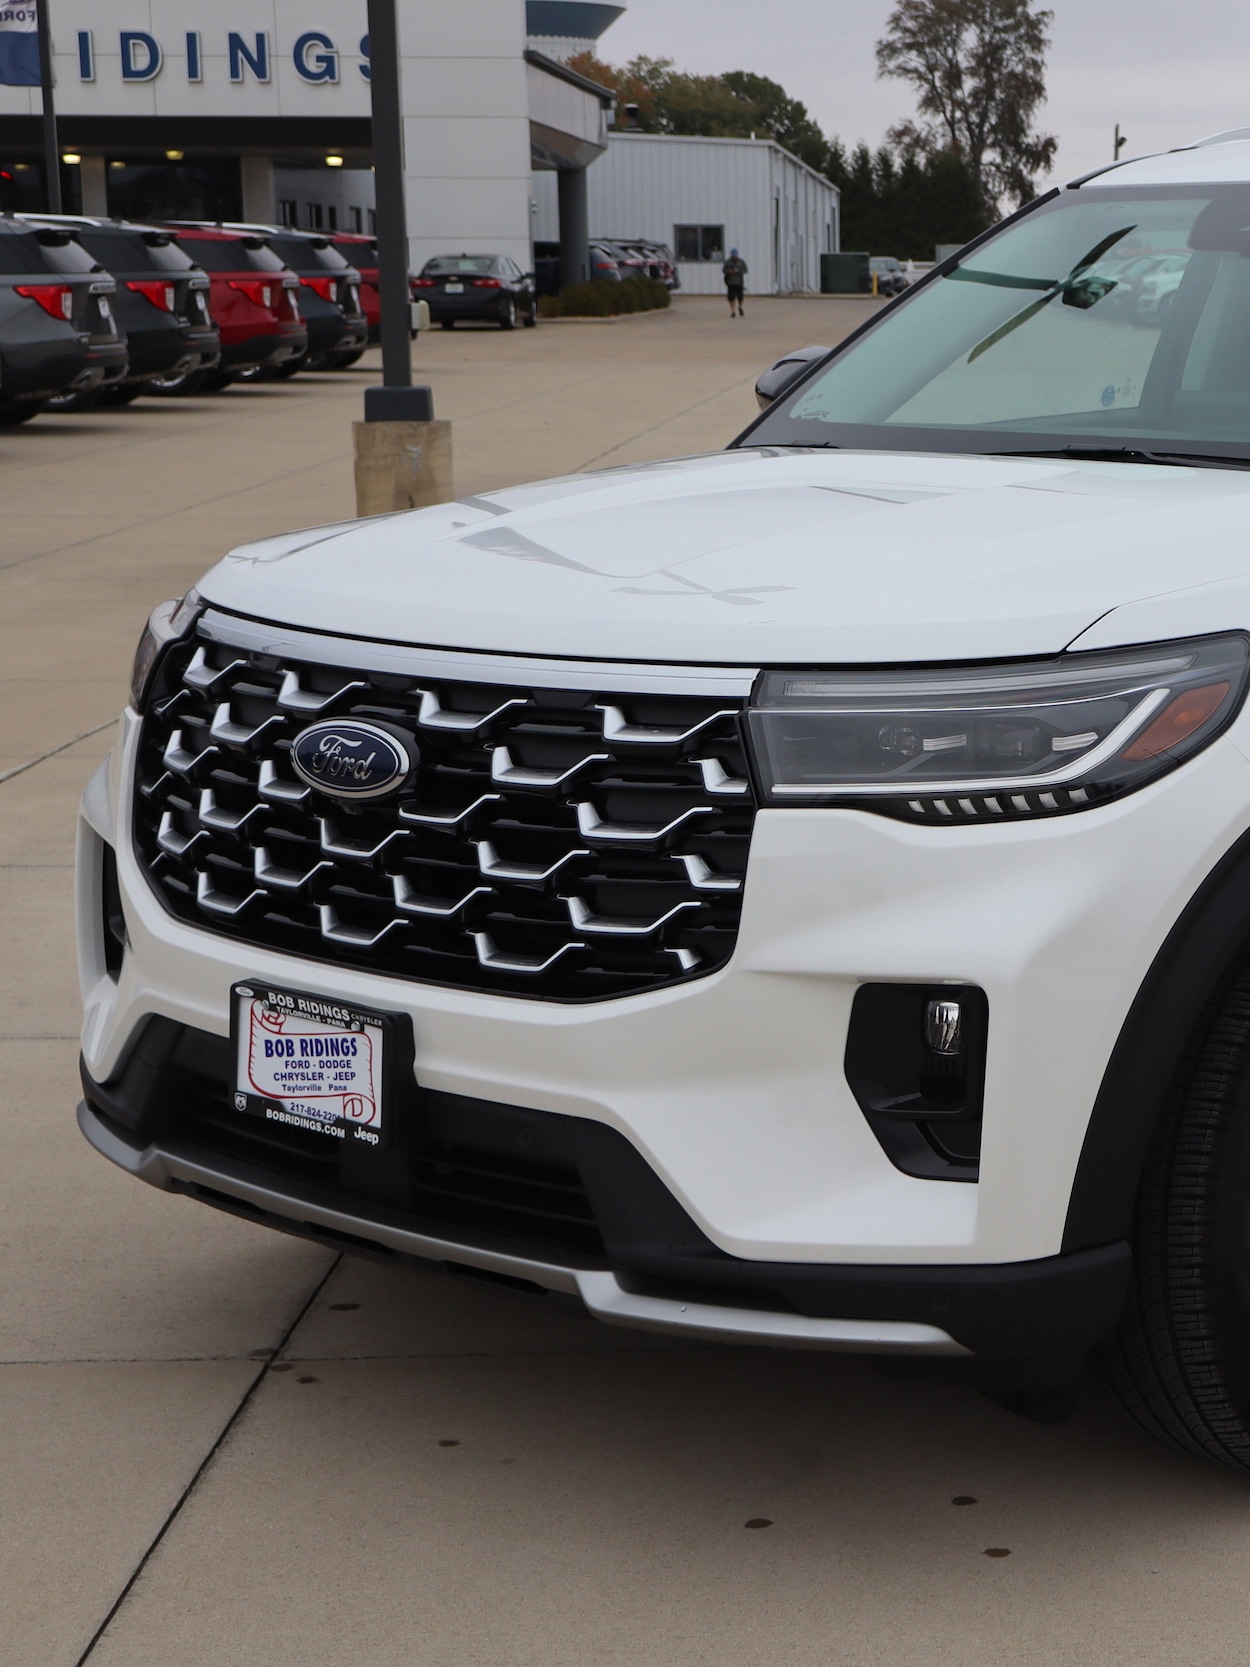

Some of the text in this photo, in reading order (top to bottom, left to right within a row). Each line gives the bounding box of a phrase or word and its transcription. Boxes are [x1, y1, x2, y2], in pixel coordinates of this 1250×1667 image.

[78, 31, 372, 84] IDING
[311, 734, 377, 781] Ford
[267, 992, 350, 1021] BOB RIDINGS
[276, 1007, 321, 1022] TAYLORVILLE
[327, 1019, 346, 1028] PANA
[351, 1014, 383, 1026] CHRYSLER
[264, 1037, 358, 1058] BOB RIDINGS
[284, 1060, 311, 1070] FORD
[318, 1059, 353, 1069] DODGE
[273, 1072, 325, 1082] CHRYSLER
[332, 1071, 357, 1081] JEEP
[281, 1083, 348, 1094] Taylorville Pana
[290, 1102, 340, 1122] 217-824-220
[266, 1108, 346, 1139] BOBRIDINGS.COM
[353, 1126, 380, 1146] Jeep
